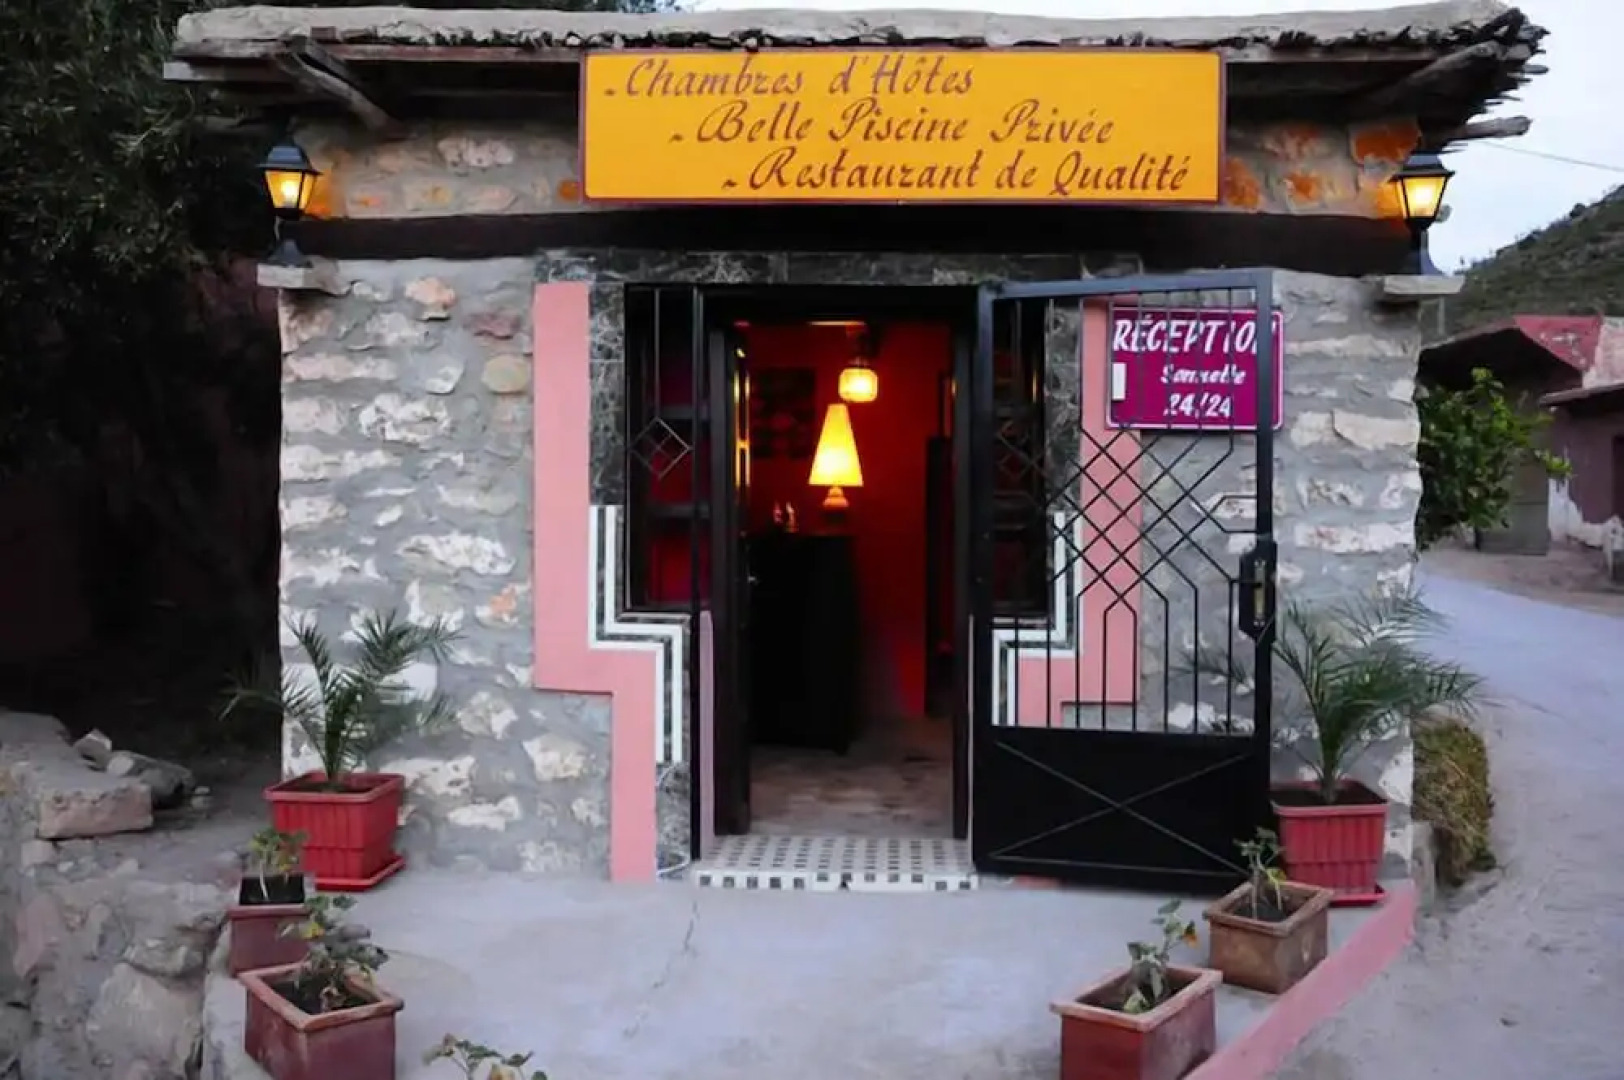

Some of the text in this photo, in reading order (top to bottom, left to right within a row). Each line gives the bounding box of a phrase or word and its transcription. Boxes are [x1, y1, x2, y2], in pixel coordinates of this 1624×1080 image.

[626, 58, 803, 97] Chambres
[697, 100, 813, 142] Belle
[828, 97, 968, 141] Piscine
[990, 98, 1114, 144] Privée
[749, 146, 983, 190] Restaurant
[995, 150, 1037, 188] de
[1050, 150, 1191, 196] Qualité
[1163, 392, 1231, 419] 24/24
